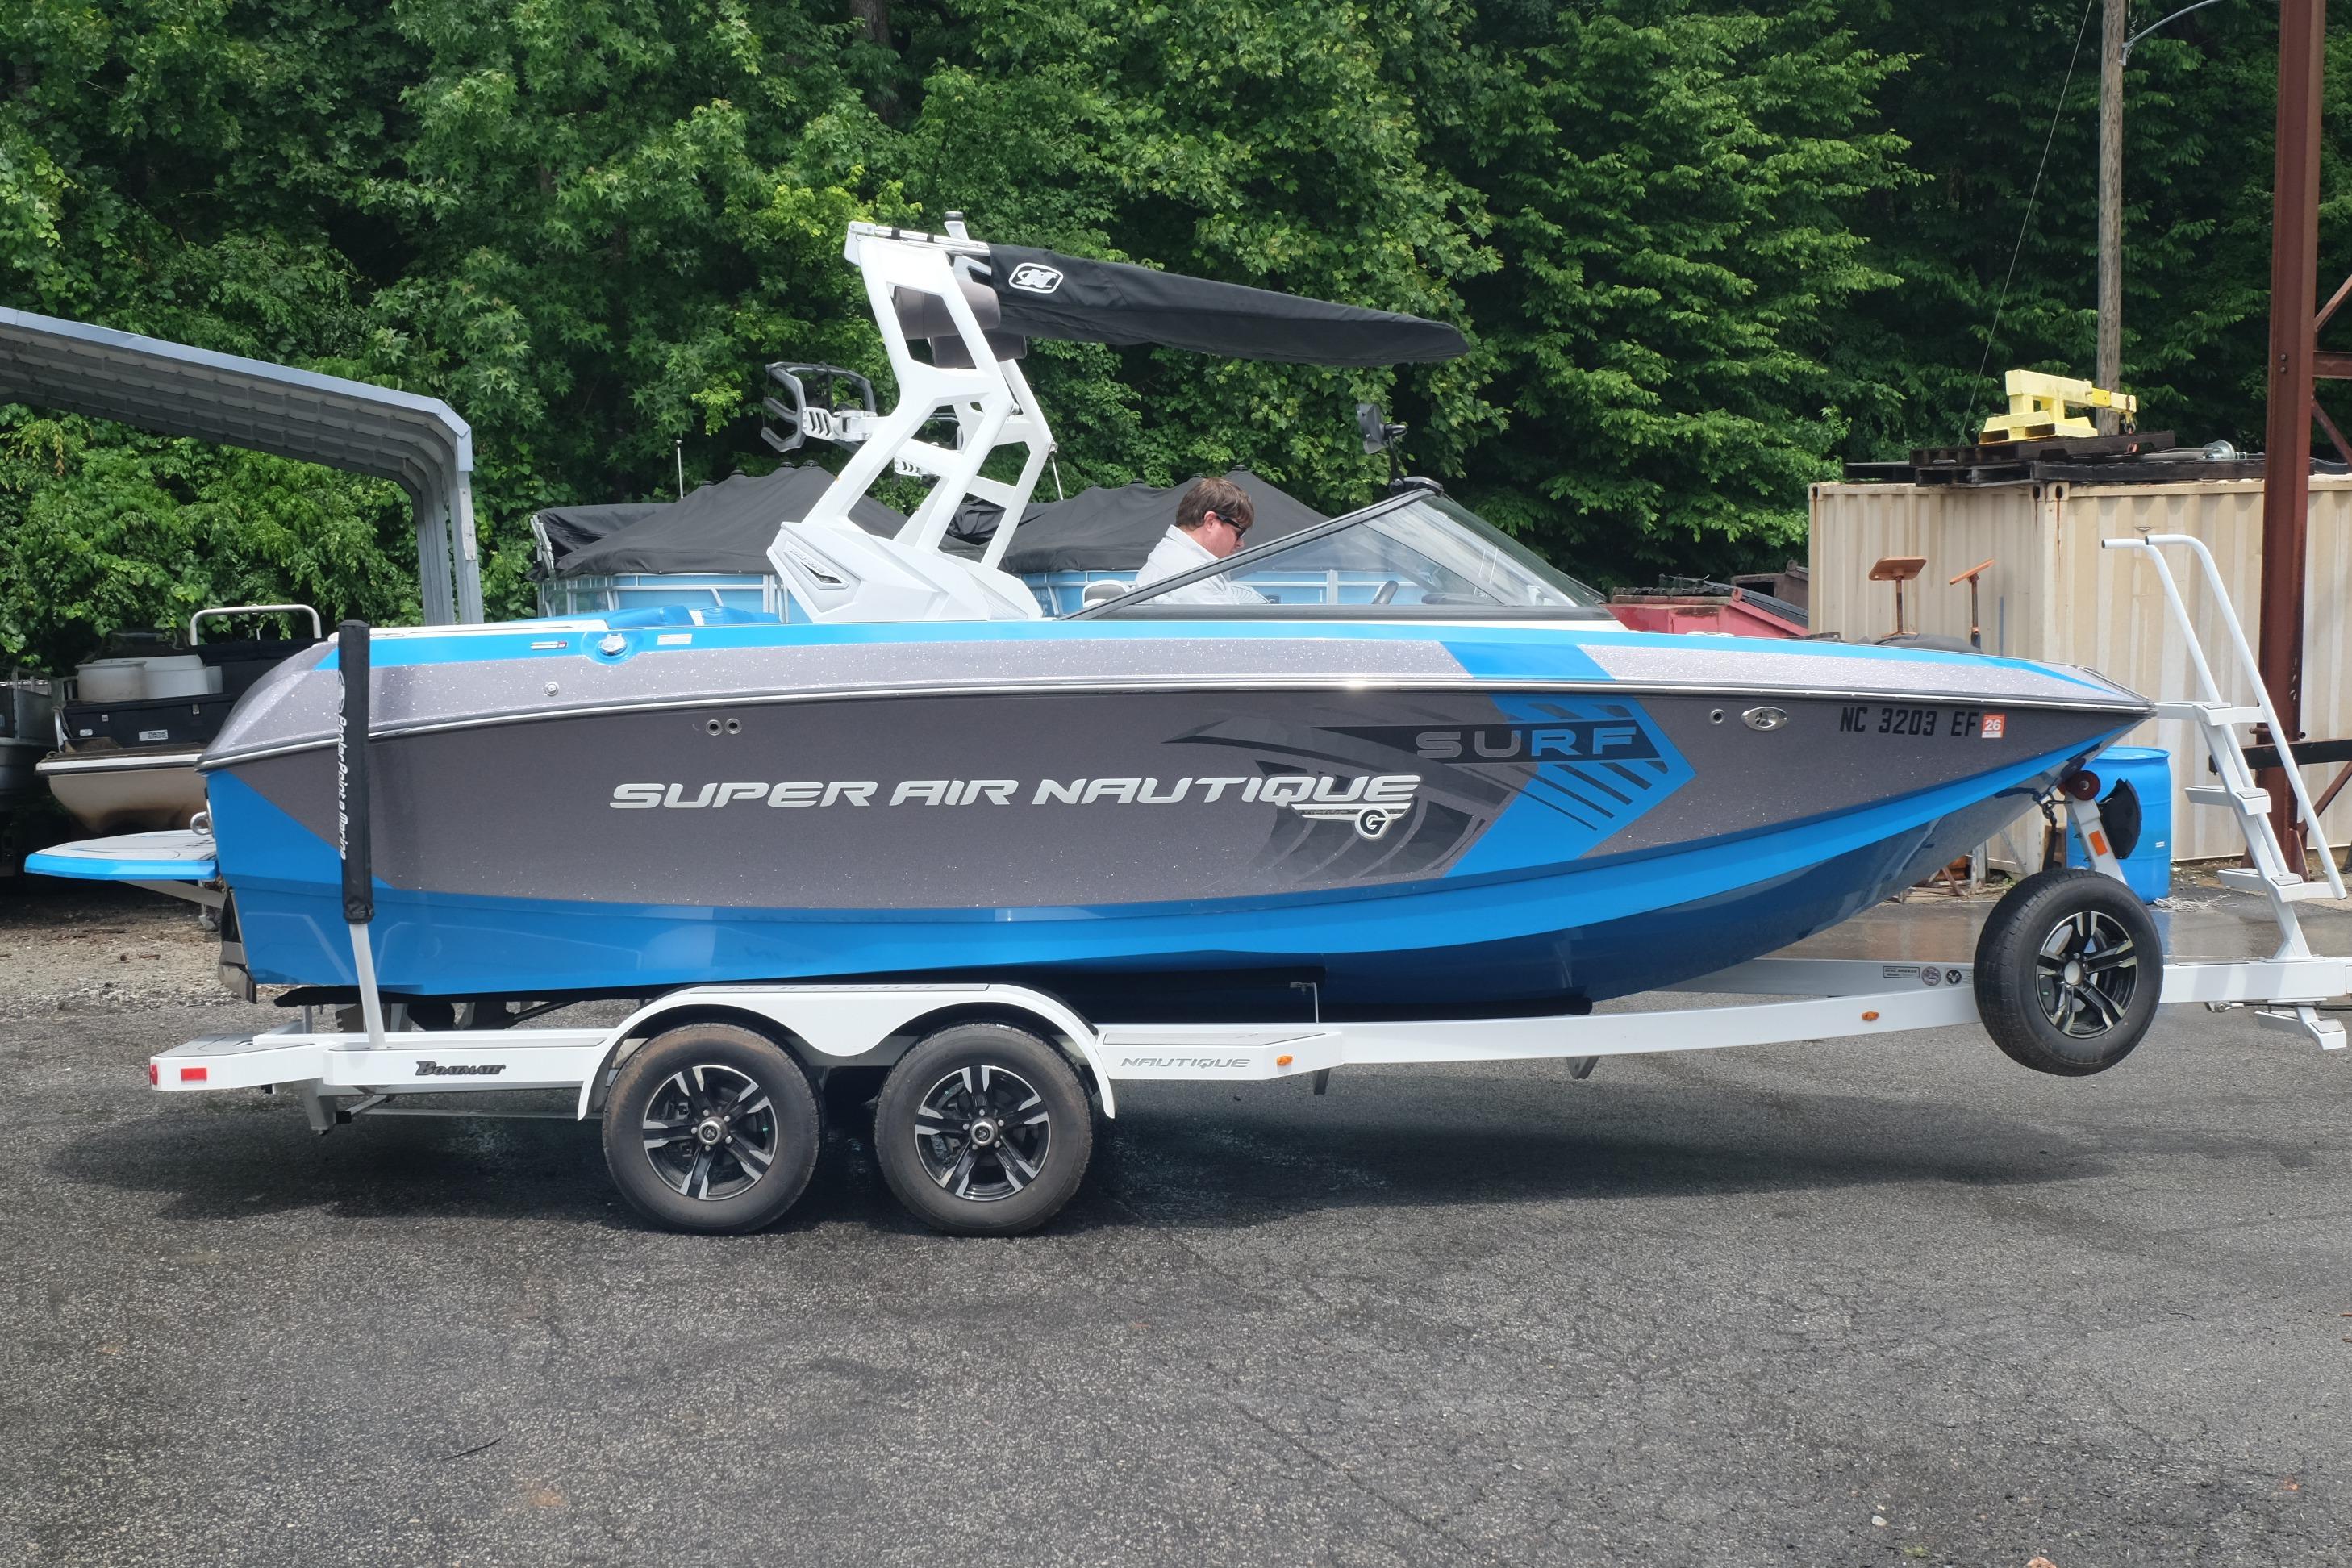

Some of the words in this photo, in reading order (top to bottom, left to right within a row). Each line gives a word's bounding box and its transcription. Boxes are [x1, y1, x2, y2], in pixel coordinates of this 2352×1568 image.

[1840, 707, 1868, 732] NC
[1878, 708, 1937, 736] 3203
[1950, 711, 1979, 737] EF
[1984, 719, 2002, 731] 26
[1416, 726, 1637, 759] SURF
[610, 781, 878, 809] SUPER
[889, 779, 1019, 807] AIR
[1032, 774, 1421, 807] NAUTIQUE
[1120, 1057, 1251, 1069] NAUTIQUE
